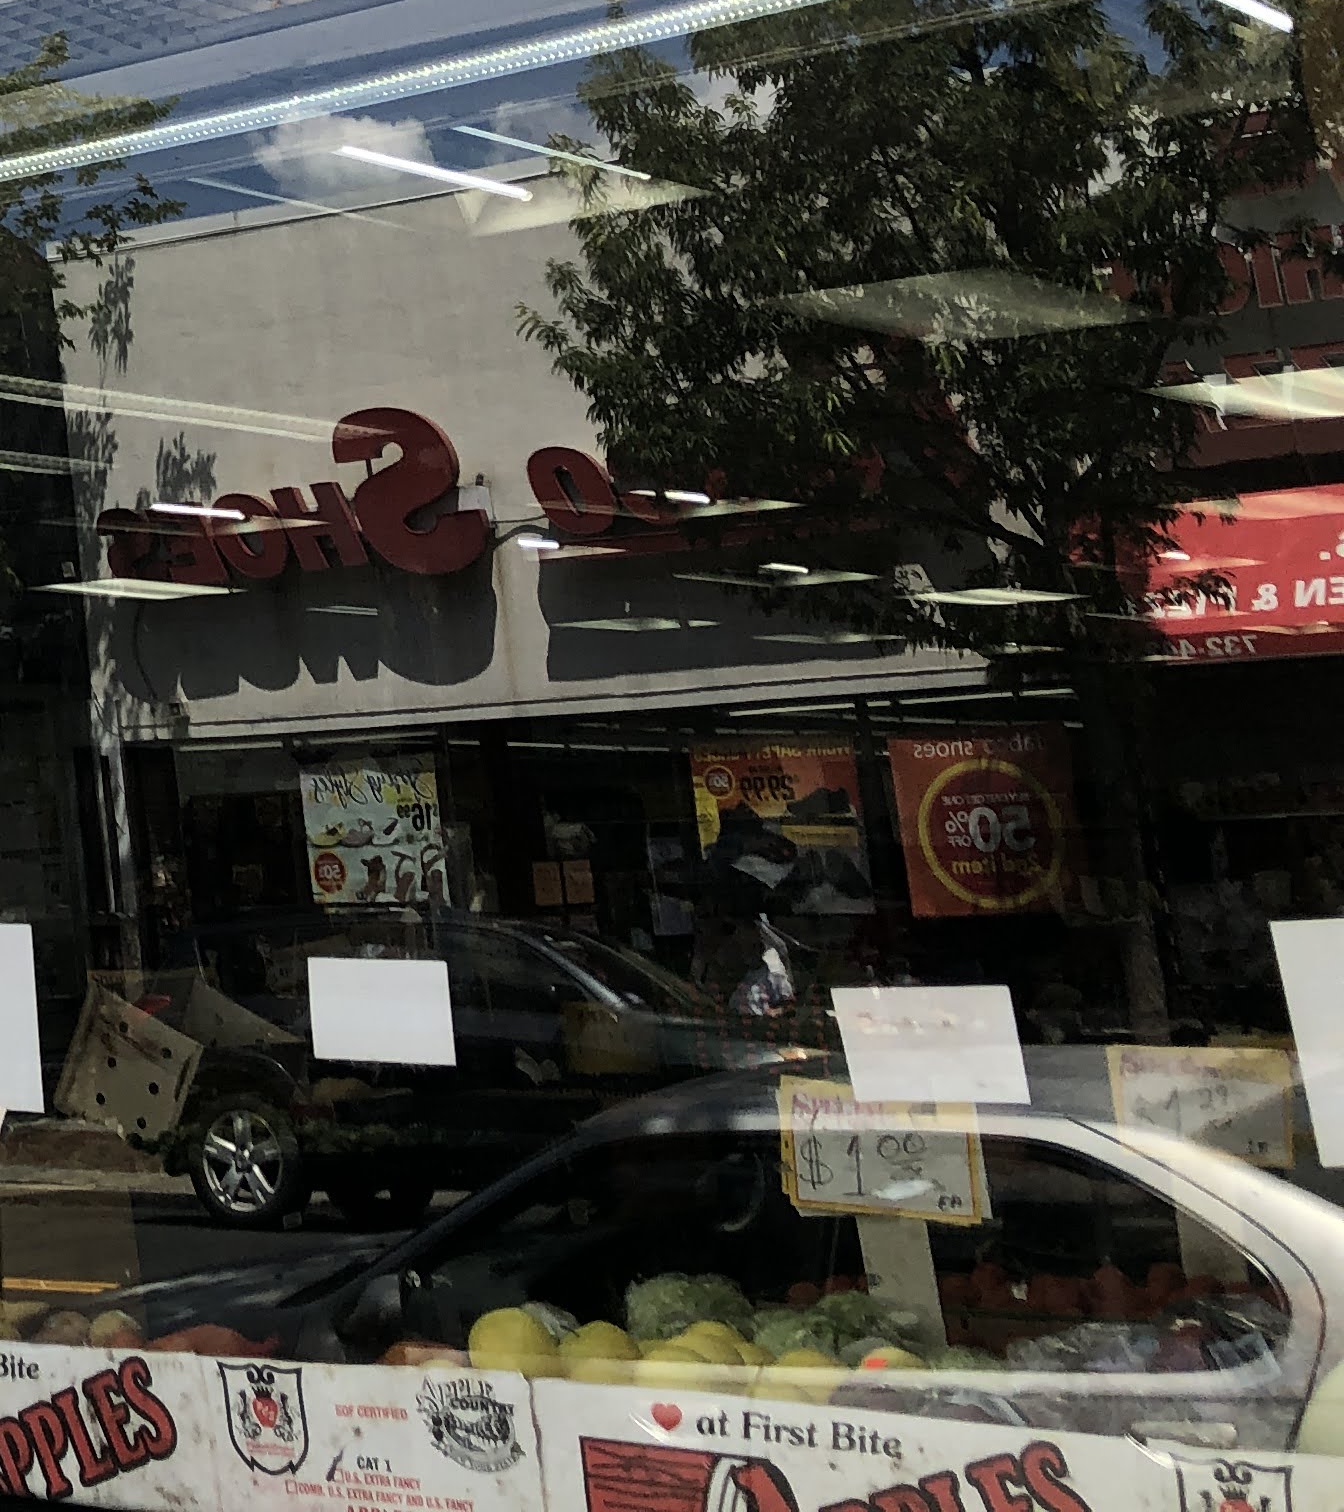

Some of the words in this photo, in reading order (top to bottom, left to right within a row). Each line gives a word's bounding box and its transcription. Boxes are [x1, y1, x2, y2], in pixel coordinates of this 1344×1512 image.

[695, 1409, 728, 1437] at
[741, 1410, 820, 1449] First
[831, 1420, 904, 1459] Bite
[356, 1455, 380, 1472] CAT
